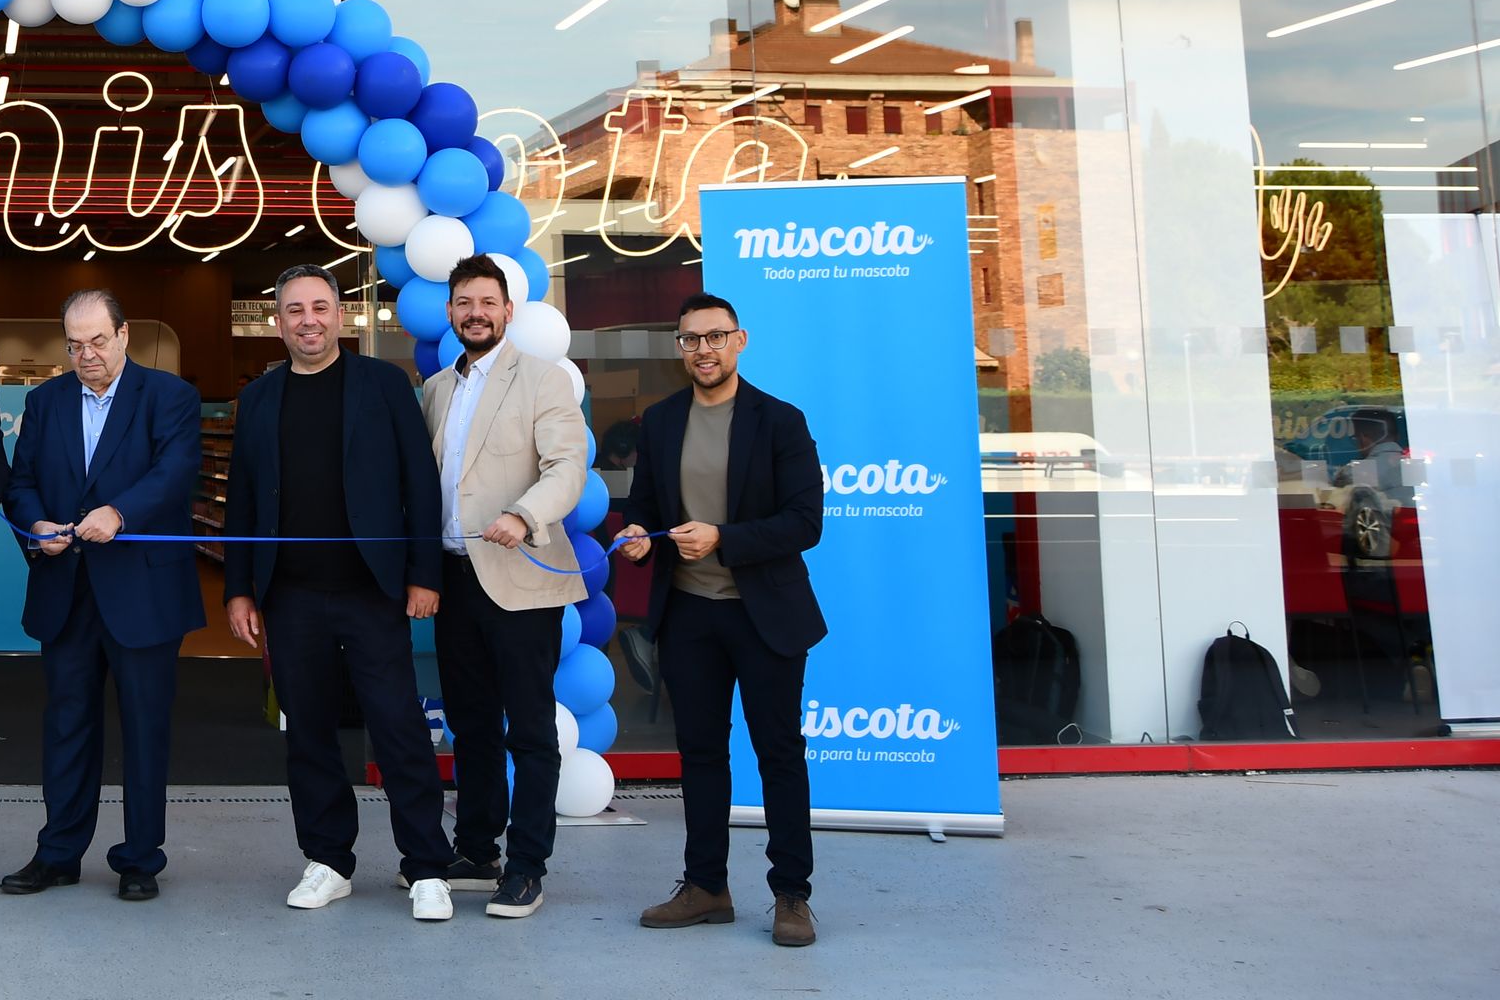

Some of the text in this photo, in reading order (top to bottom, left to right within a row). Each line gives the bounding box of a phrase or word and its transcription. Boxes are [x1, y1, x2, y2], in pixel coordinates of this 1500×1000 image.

[733, 221, 930, 259] miscota
[763, 264, 910, 282] Todo para tu mascota
[820, 459, 943, 495] scota
[822, 503, 924, 517] ara tu mascota
[801, 699, 956, 741] iscota
[819, 749, 853, 763] para
[856, 747, 871, 761] tu
[874, 749, 936, 763] mascota
